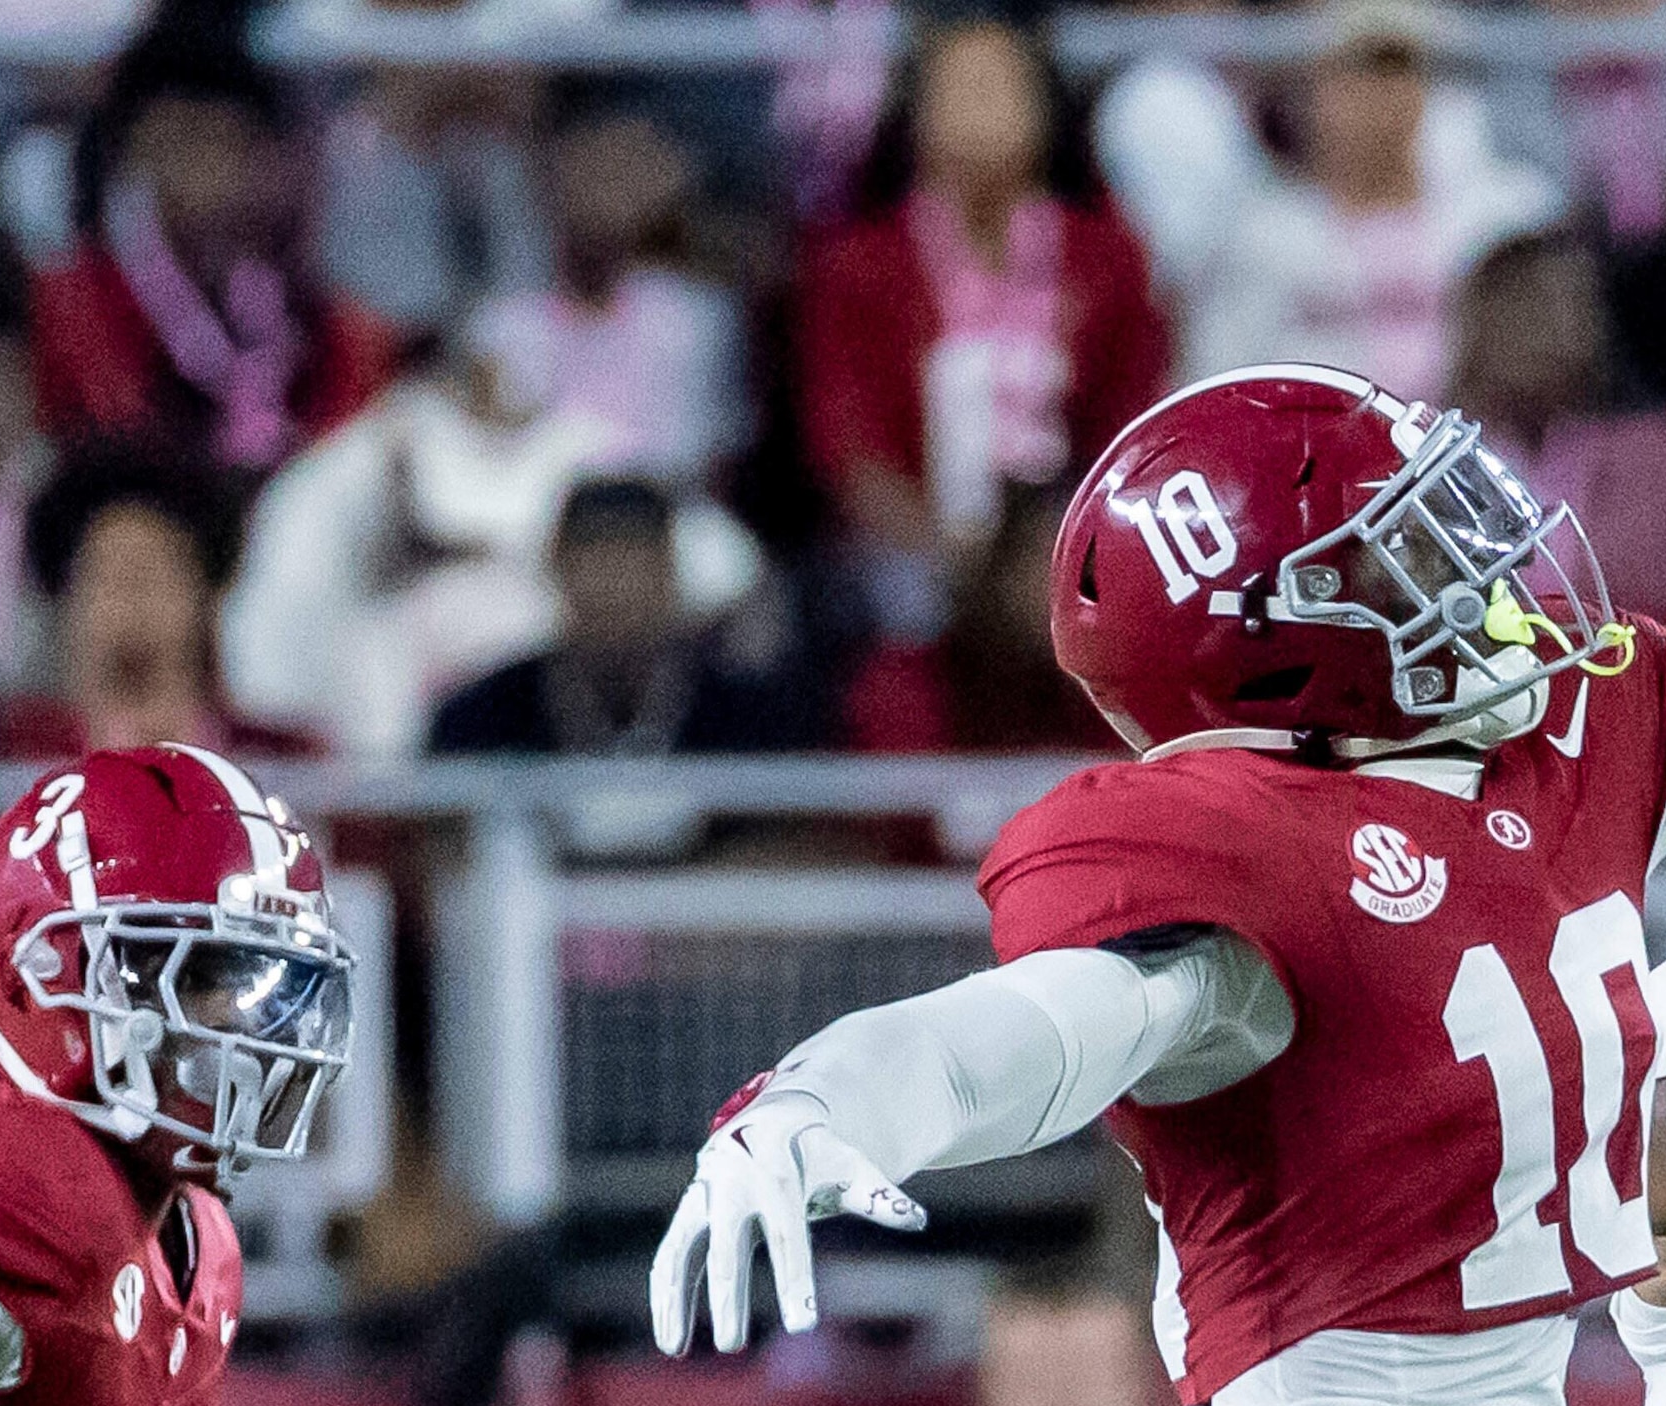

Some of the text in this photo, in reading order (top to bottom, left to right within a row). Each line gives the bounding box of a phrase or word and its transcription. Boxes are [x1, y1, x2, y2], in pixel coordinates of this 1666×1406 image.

[1130, 470, 1237, 604] 10
[9, 773, 86, 860] 3
[1352, 823, 1423, 893] SEC
[1367, 879, 1443, 918] GRADUATE
[1442, 889, 1658, 1311] 10
